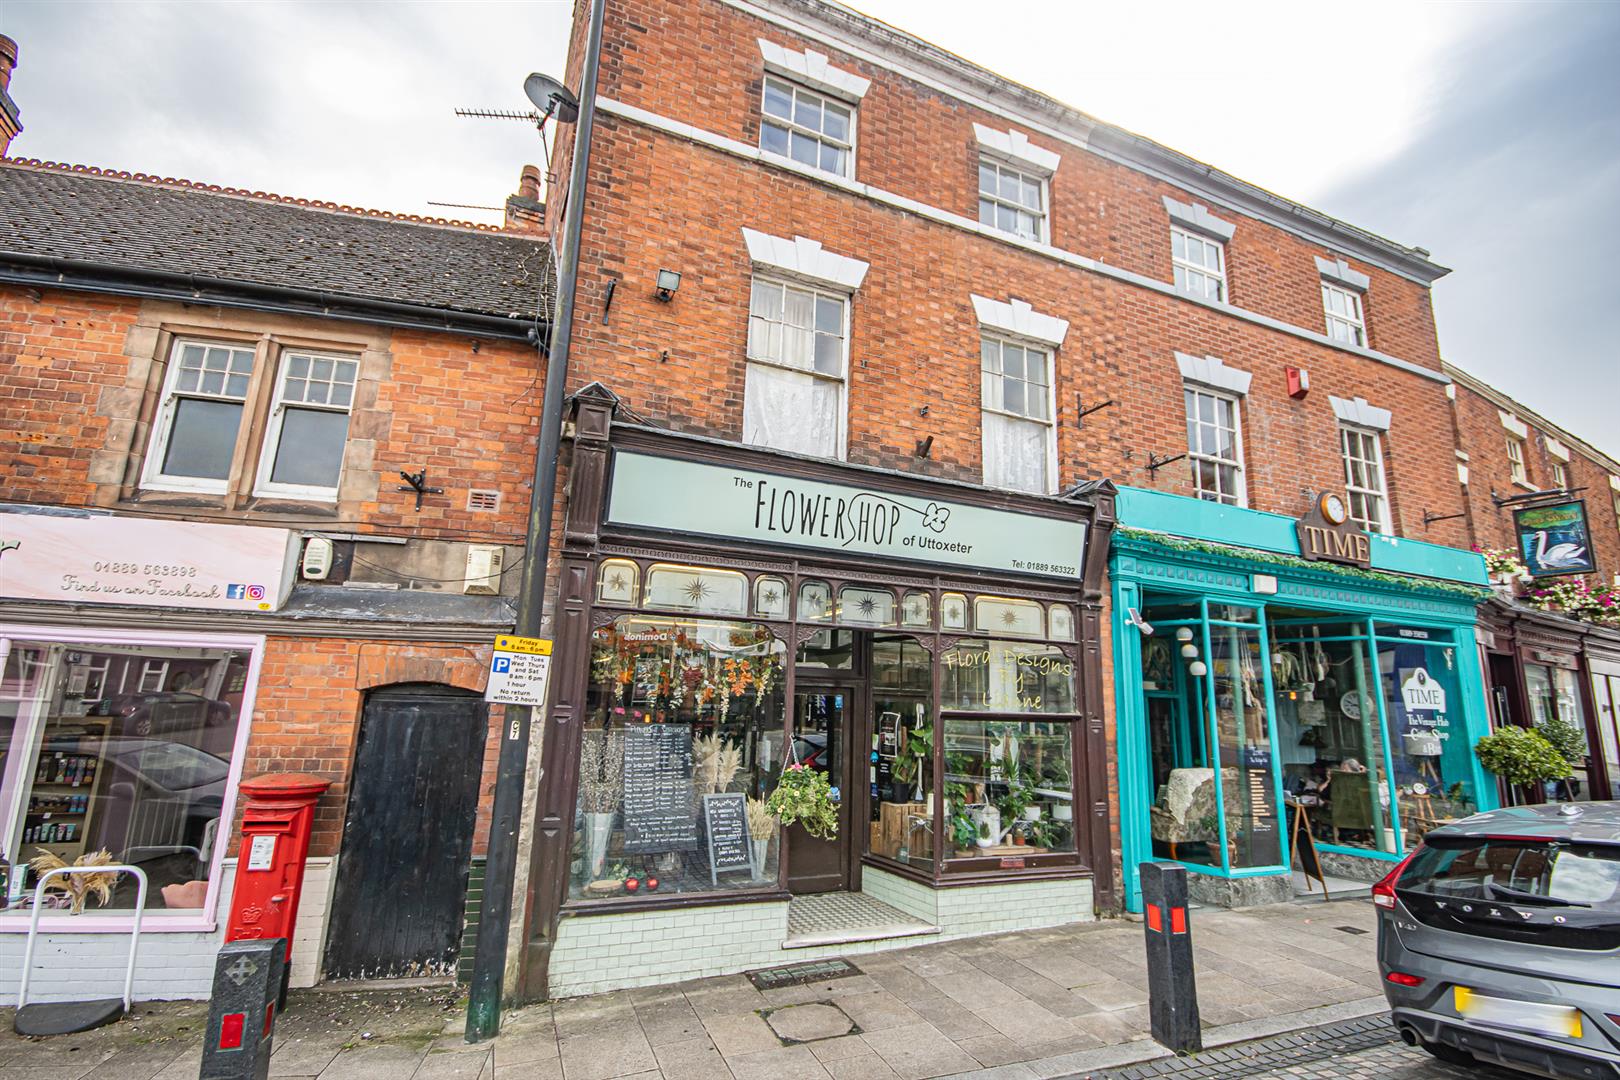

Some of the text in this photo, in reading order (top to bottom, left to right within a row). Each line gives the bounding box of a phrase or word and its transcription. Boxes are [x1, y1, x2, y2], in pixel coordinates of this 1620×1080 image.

[733, 476, 753, 489] The
[902, 535, 973, 554] of Uttoxeter
[1305, 525, 1370, 562] TIME
[93, 560, 197, 578] 01889 563898
[1012, 559, 1076, 575] Tel: 01889 563322
[60, 573, 221, 599] Find us on Facebook
[519, 639, 538, 647] Friday
[1004, 649, 1073, 677] Designs
[1407, 688, 1441, 705] TIME
[1435, 901, 1567, 923] VOLVO
